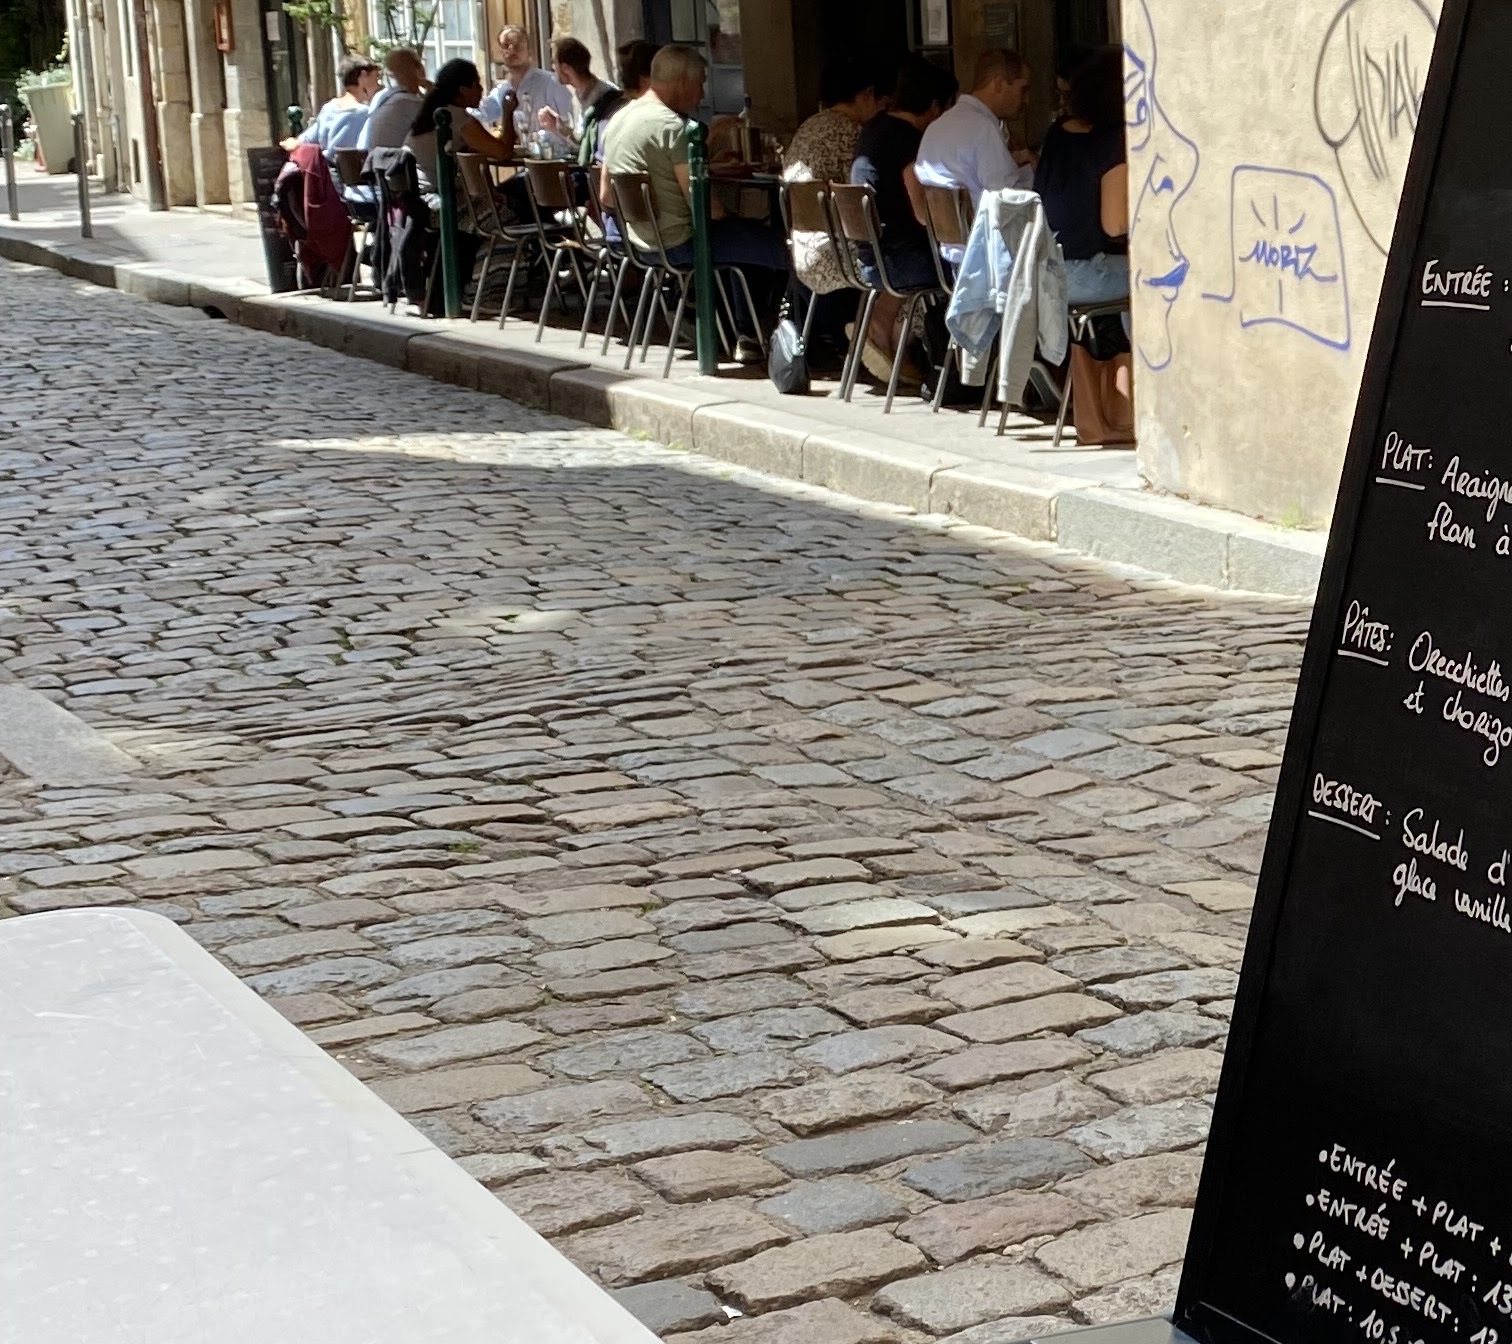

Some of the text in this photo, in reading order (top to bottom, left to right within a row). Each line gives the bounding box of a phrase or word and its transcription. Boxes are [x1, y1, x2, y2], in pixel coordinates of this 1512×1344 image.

[1495, 523, 1510, 556] à
[1402, 680, 1425, 714] et
[1402, 807, 1469, 872] Salade
[1392, 857, 1512, 934] glace vanille
[1431, 1200, 1485, 1242] PLAT
[1308, 1230, 1352, 1272] PLAT
